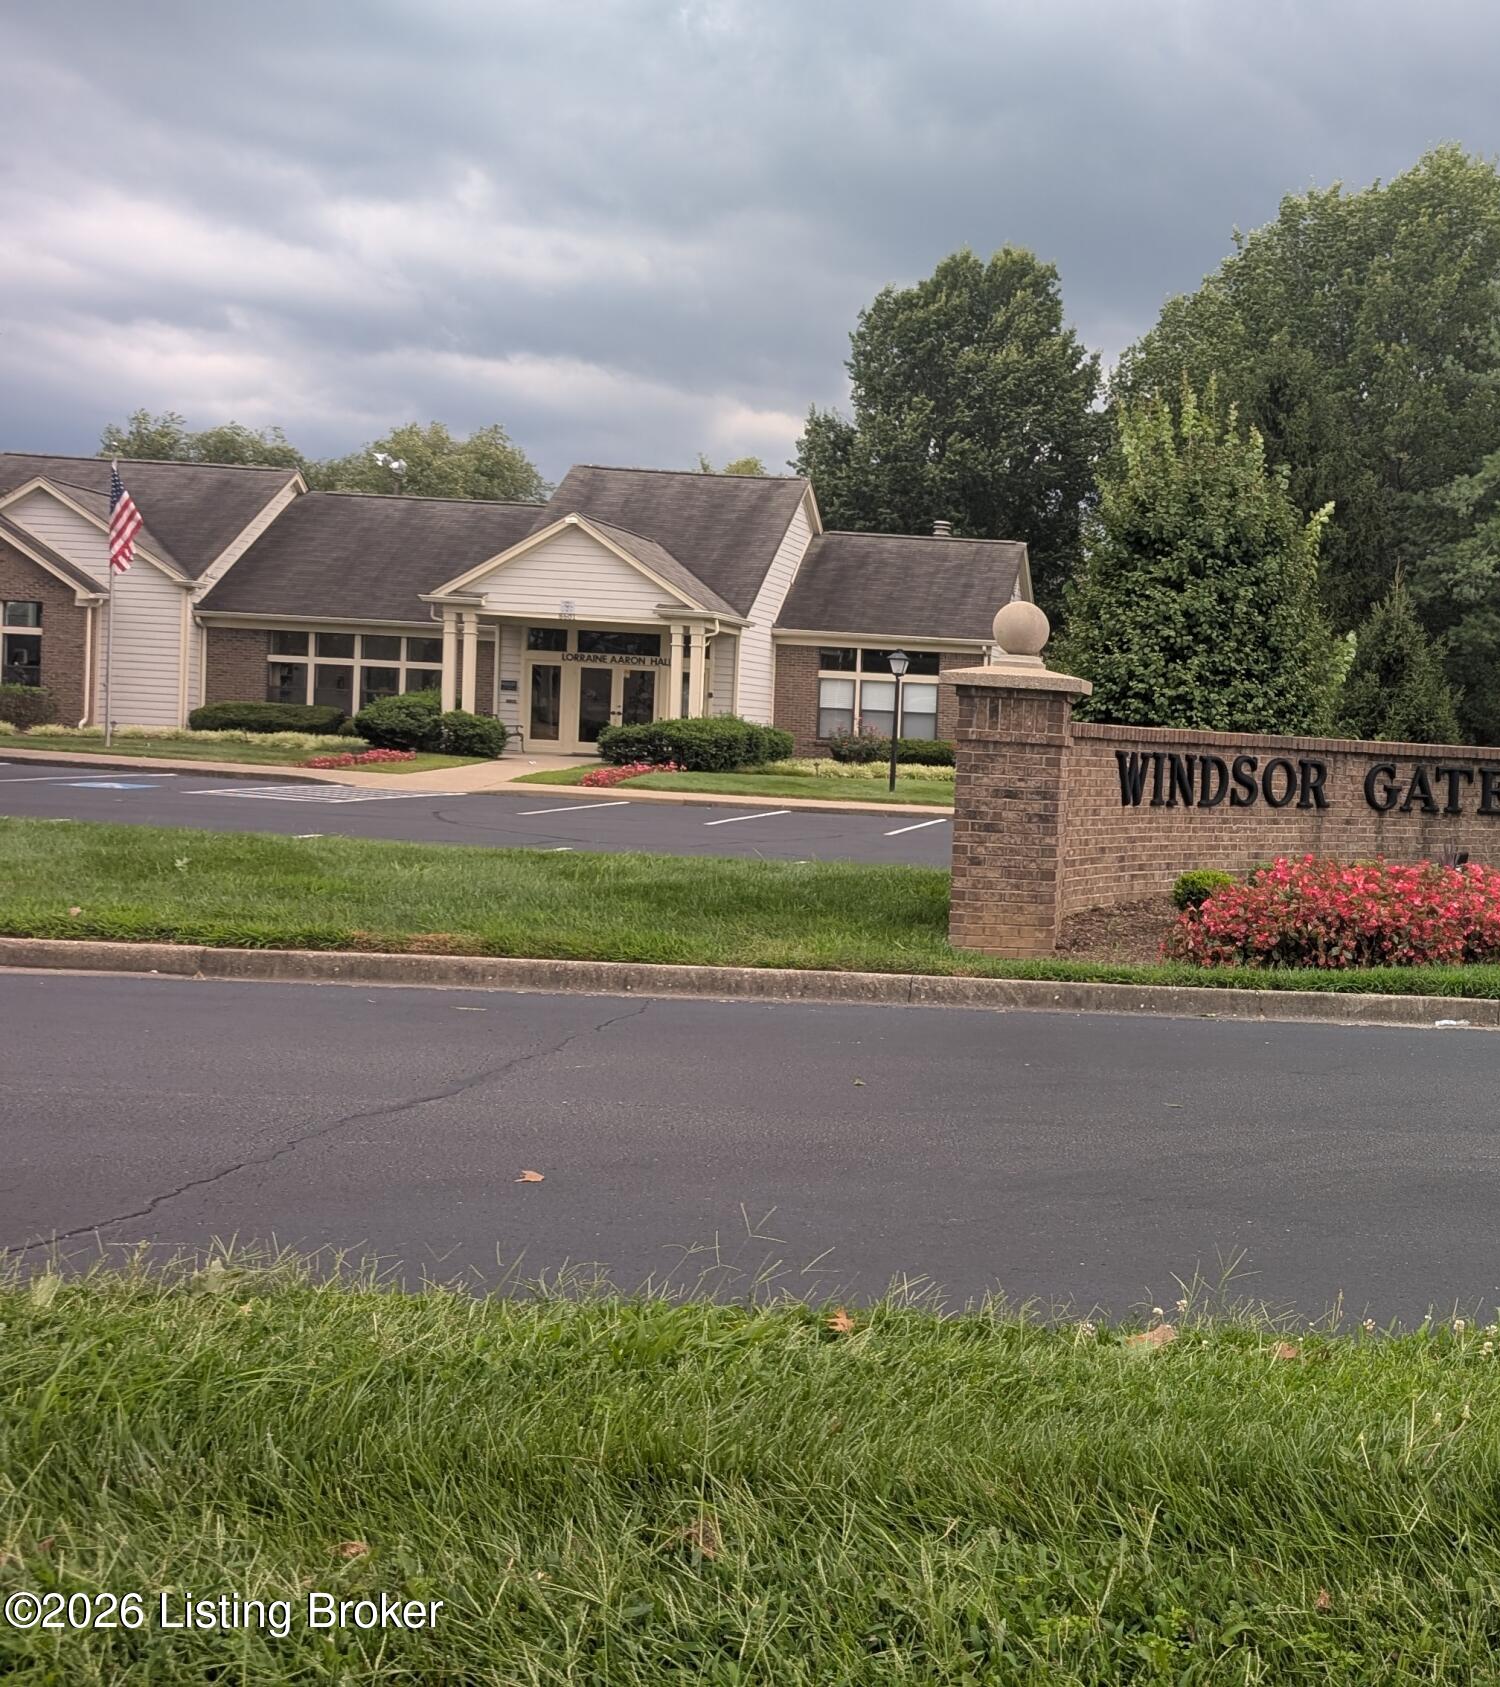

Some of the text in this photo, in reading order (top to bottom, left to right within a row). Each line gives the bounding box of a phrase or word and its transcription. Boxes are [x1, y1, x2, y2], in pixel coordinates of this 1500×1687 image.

[561, 653, 608, 664] LORRAINE
[610, 655, 646, 665] AARON
[1115, 750, 1330, 809] WINDSOR
